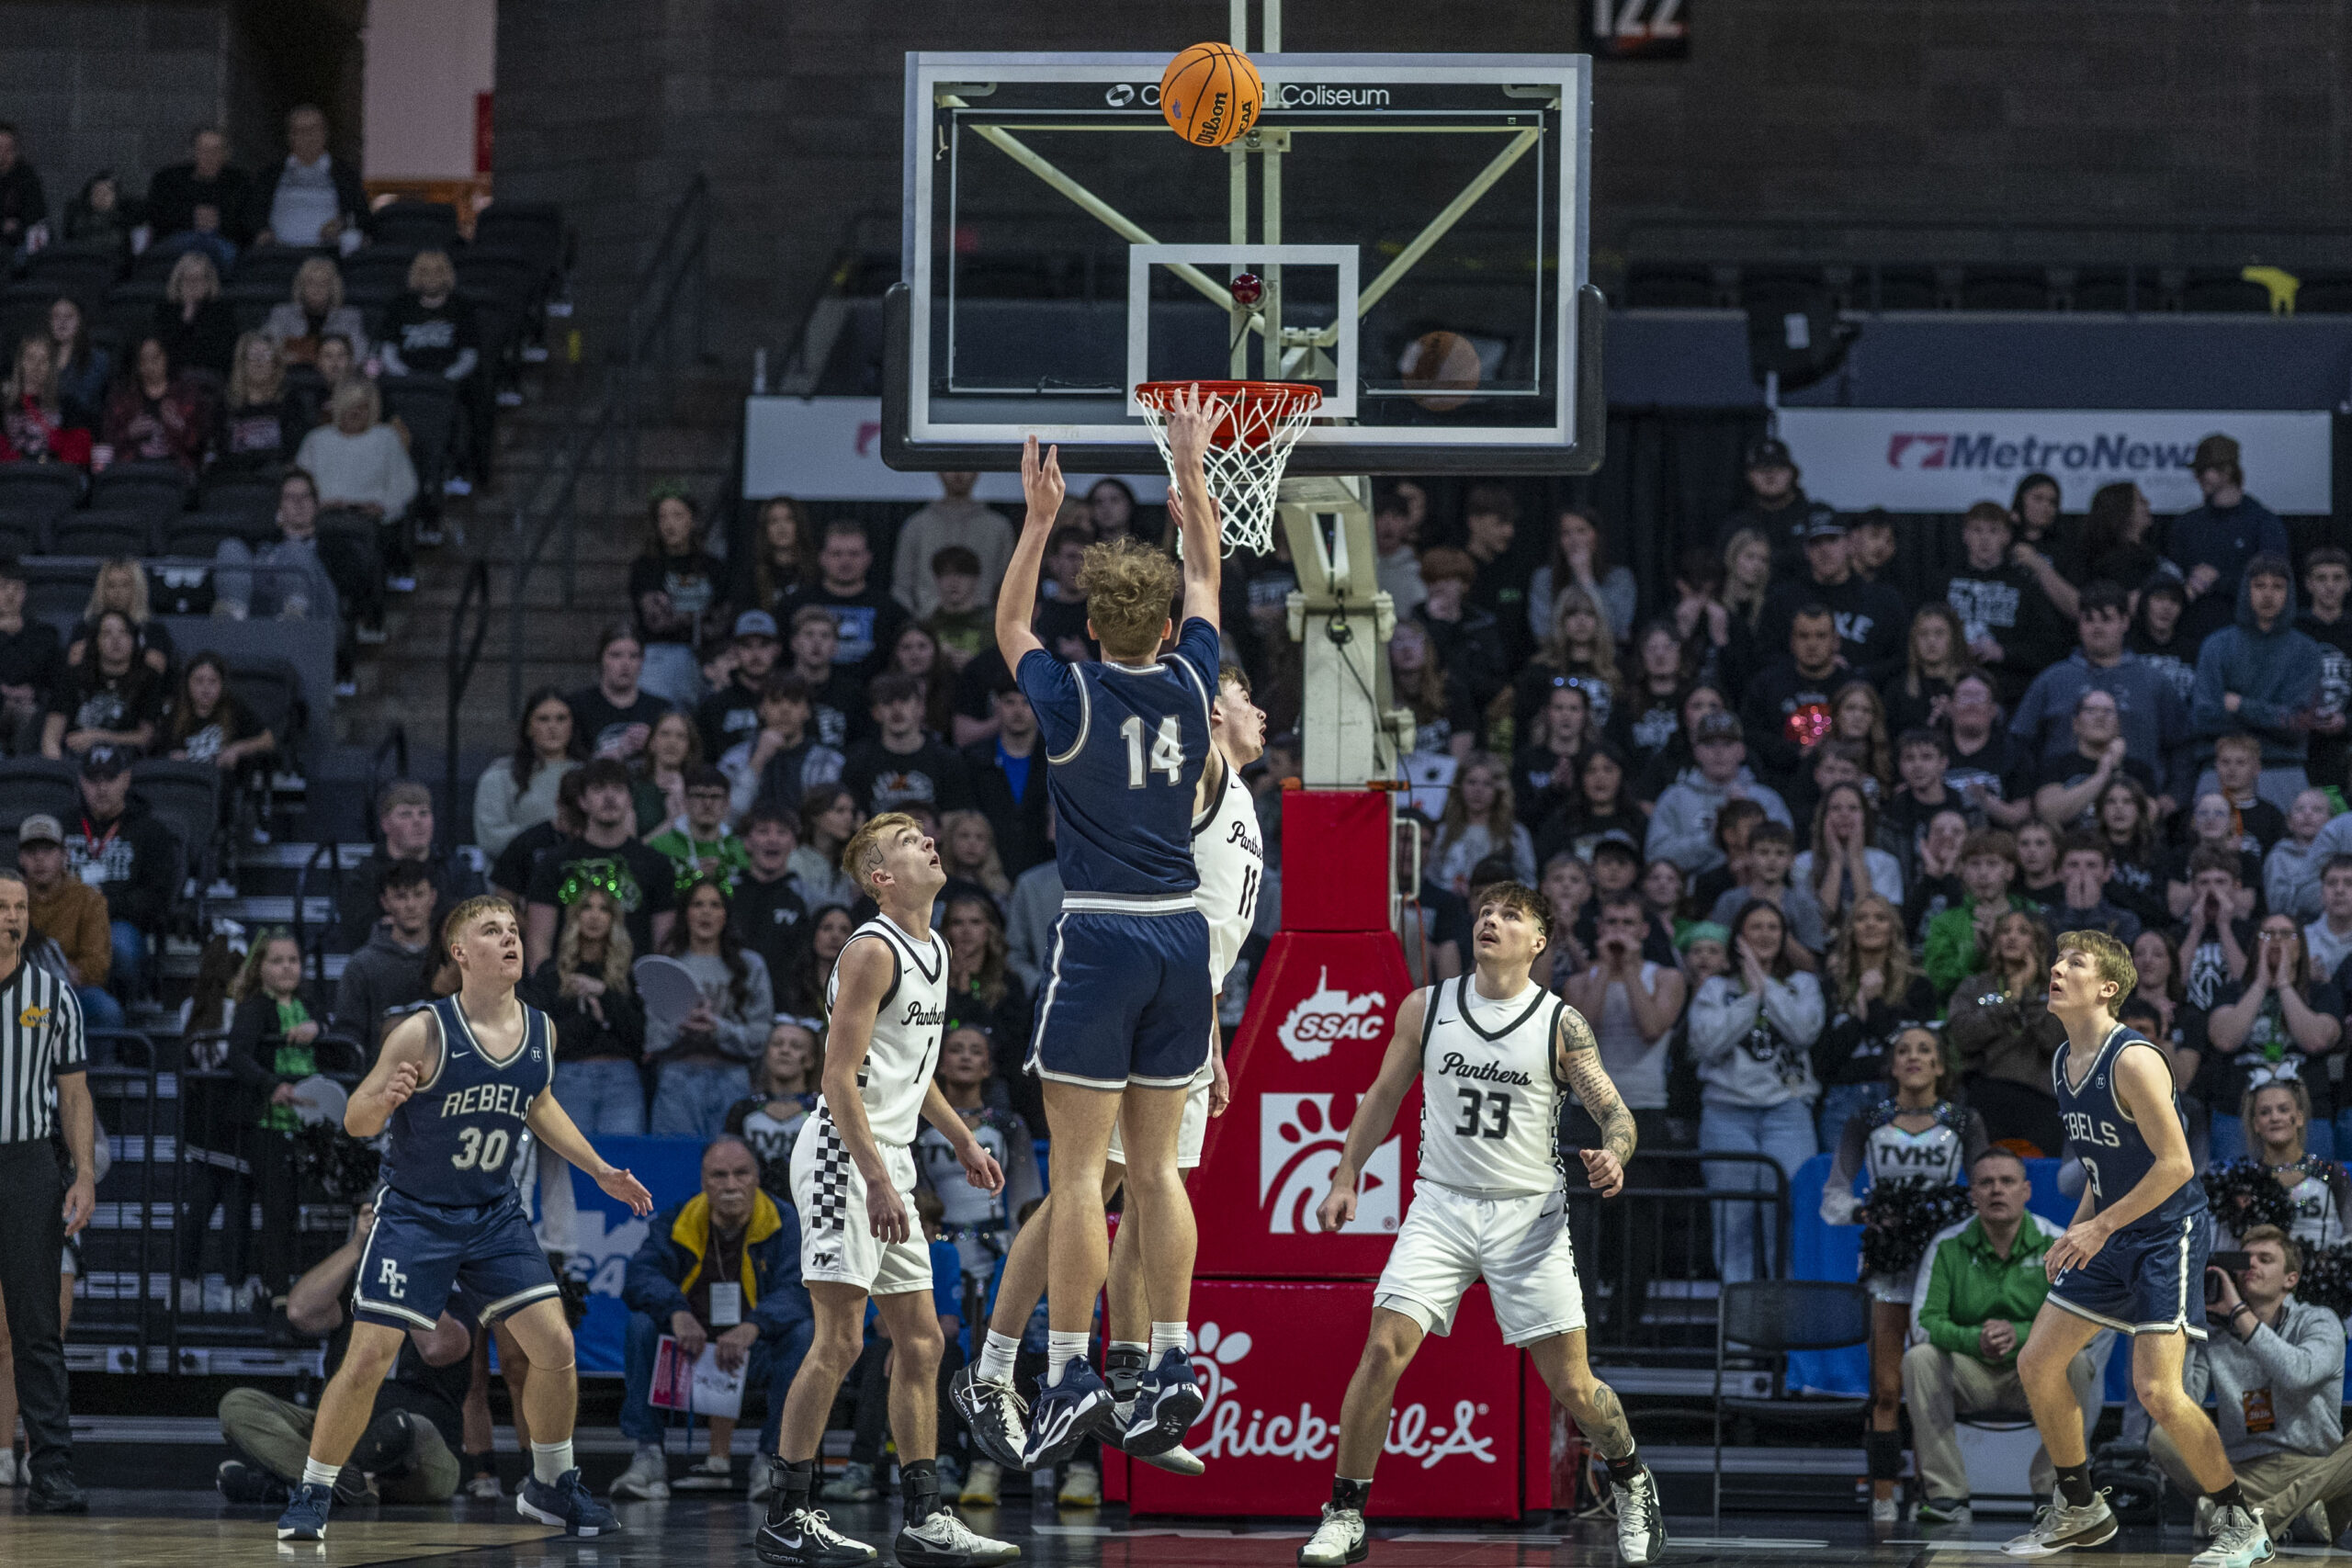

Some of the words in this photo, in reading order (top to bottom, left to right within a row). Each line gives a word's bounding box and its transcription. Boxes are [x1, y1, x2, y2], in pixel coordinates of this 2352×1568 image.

[1281, 85, 1390, 106] Coliseum
[1195, 92, 1228, 144] Wilson
[1119, 715, 1186, 790] 14
[1238, 863, 1258, 919] 11
[900, 1000, 944, 1026] Panther
[1295, 1013, 1385, 1042] SSAC
[913, 1036, 934, 1085] 1
[1438, 1052, 1532, 1086] Panthers
[440, 1083, 535, 1122] REBELS
[1455, 1088, 1512, 1140] 33
[450, 1126, 510, 1173] 30
[1879, 1145, 1948, 1167] TVHS
